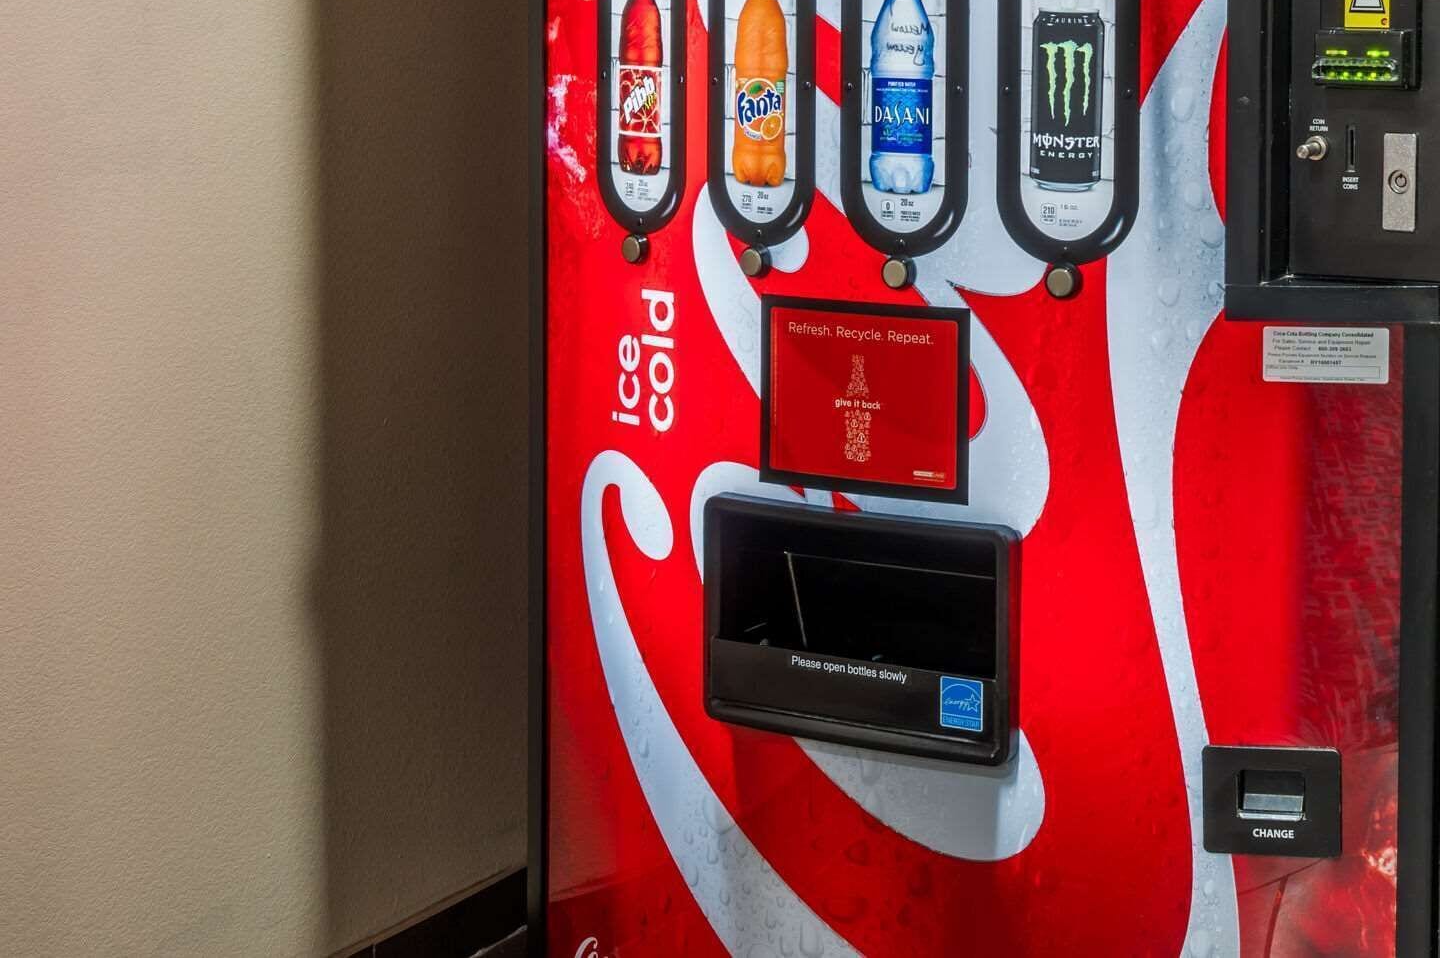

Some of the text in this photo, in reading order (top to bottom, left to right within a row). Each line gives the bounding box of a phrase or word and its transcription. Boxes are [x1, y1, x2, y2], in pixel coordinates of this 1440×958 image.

[623, 76, 656, 124] Pibb
[737, 89, 782, 126] Fanta
[874, 103, 930, 126] DASANI
[1032, 132, 1100, 150] MONSTER
[1039, 151, 1094, 159] ENERGY
[788, 322, 934, 346] Refresh. Recycle. Repeat.
[641, 289, 674, 432] cold
[612, 334, 640, 426] ice
[835, 397, 881, 410] give it back
[791, 655, 907, 684] Please open bottles slowly
[1253, 828, 1294, 839] CHANGE
